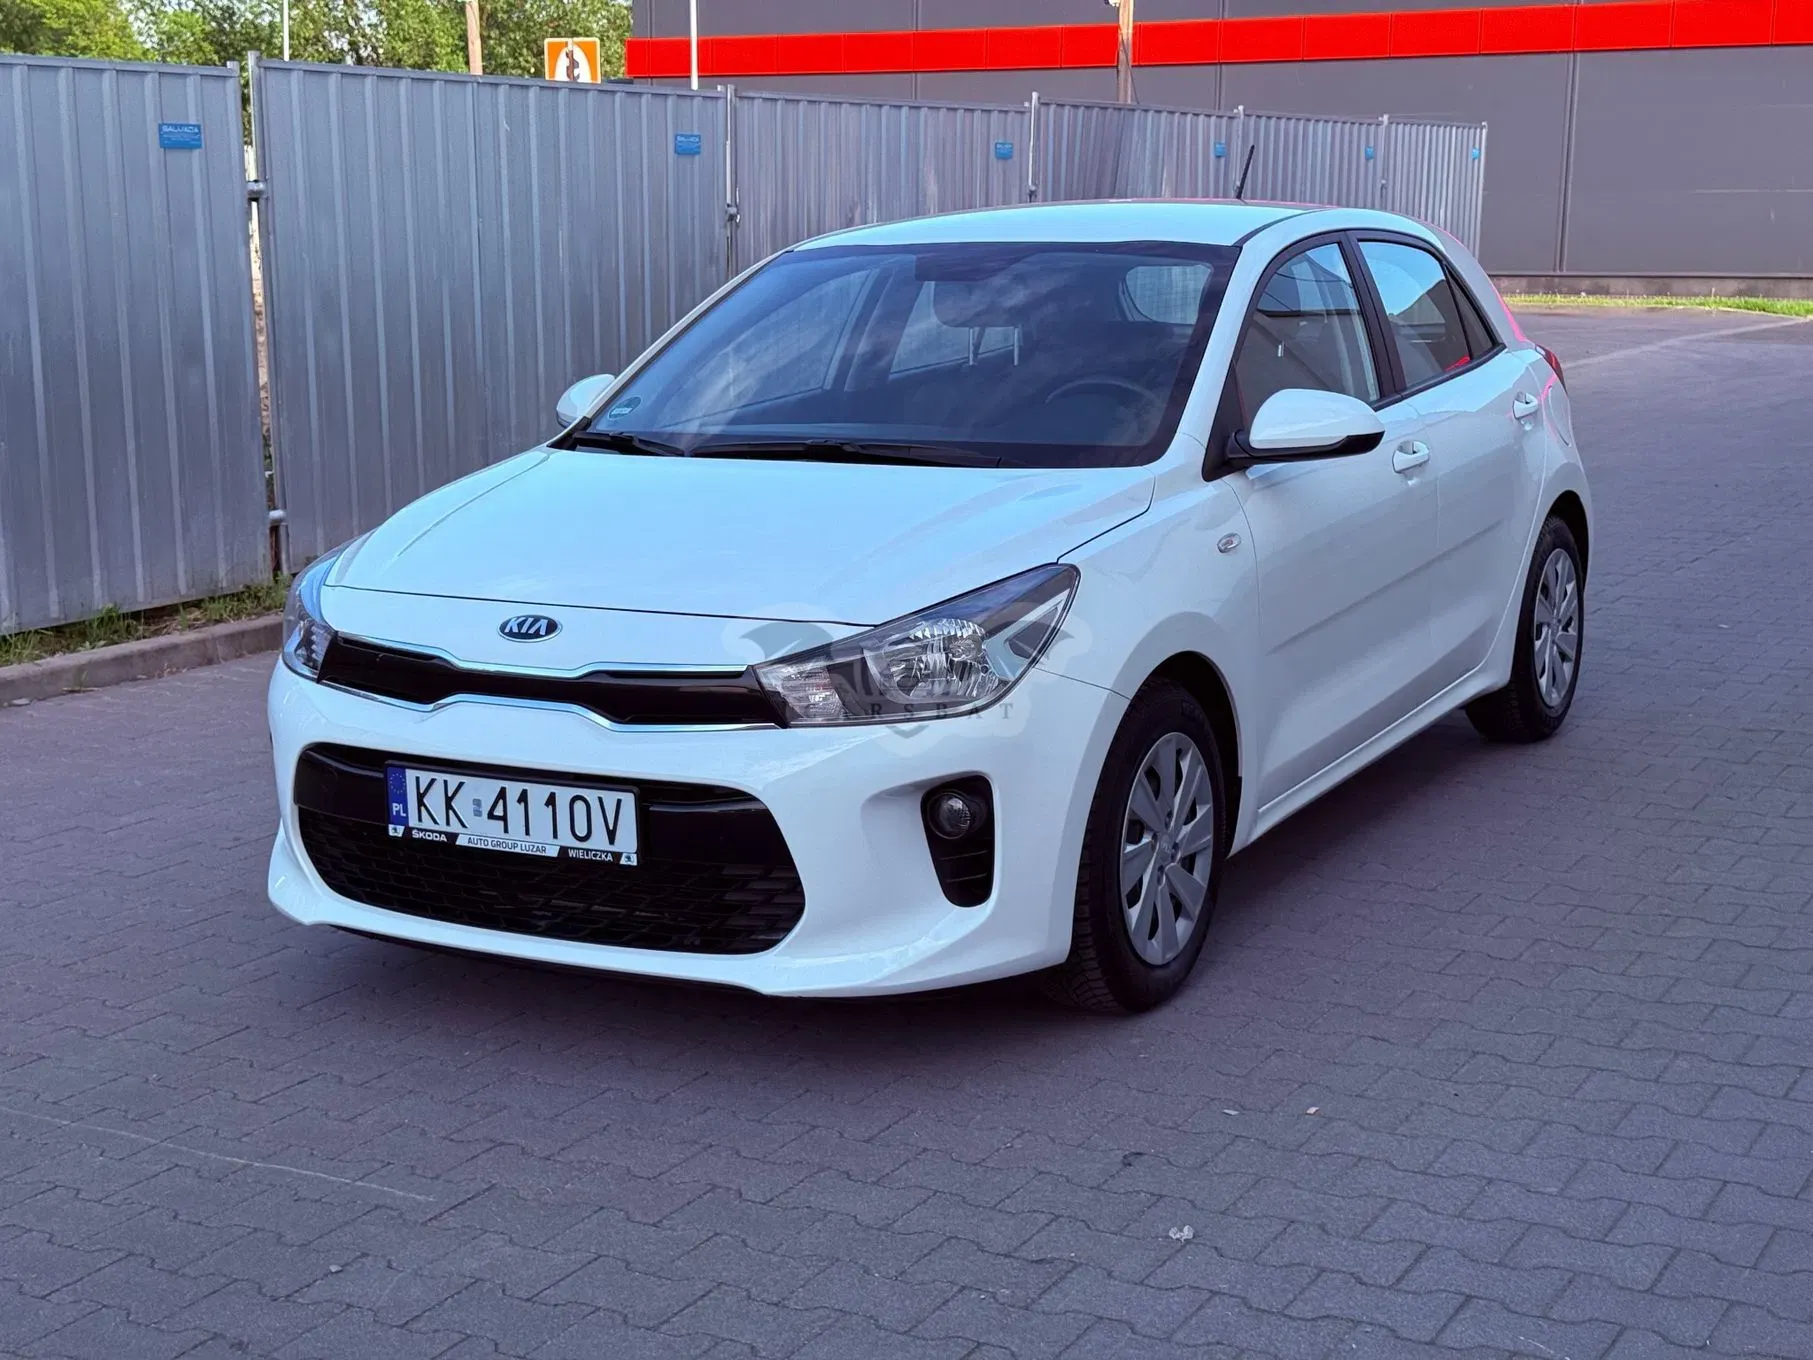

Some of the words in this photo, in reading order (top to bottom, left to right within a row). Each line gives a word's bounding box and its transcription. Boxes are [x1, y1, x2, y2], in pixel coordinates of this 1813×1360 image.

[504, 616, 549, 636] KIA
[392, 802, 407, 817] PL
[415, 775, 469, 829] KK
[486, 786, 623, 846] 4110V
[467, 836, 489, 847] AUTO
[490, 839, 519, 851] GROUP
[520, 844, 547, 854] LUZAR
[567, 848, 613, 862] WIELICZKA
